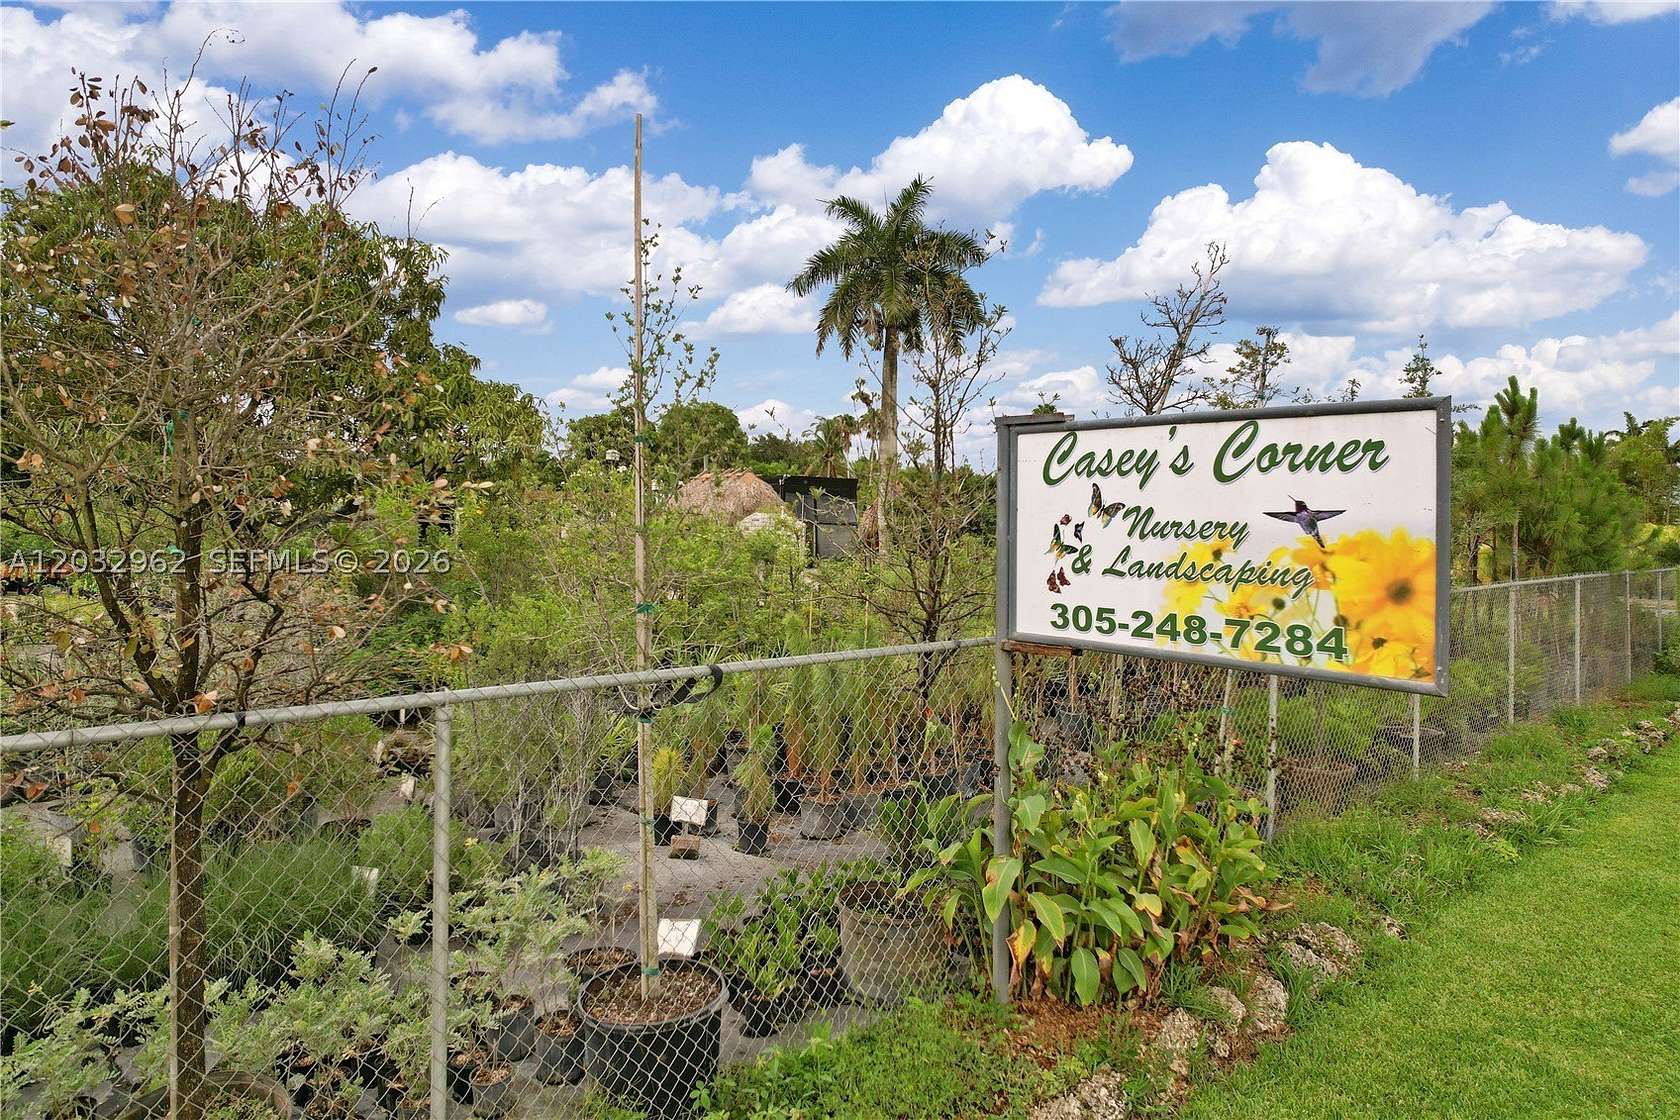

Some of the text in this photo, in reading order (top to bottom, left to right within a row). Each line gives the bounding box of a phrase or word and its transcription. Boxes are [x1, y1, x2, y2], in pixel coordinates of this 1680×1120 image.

[1042, 420, 1389, 489] Casey's Corner
[1122, 505, 1250, 551] Nursery
[1071, 544, 1314, 599] & Landscaping
[1049, 602, 1349, 660] 305-248-7284
